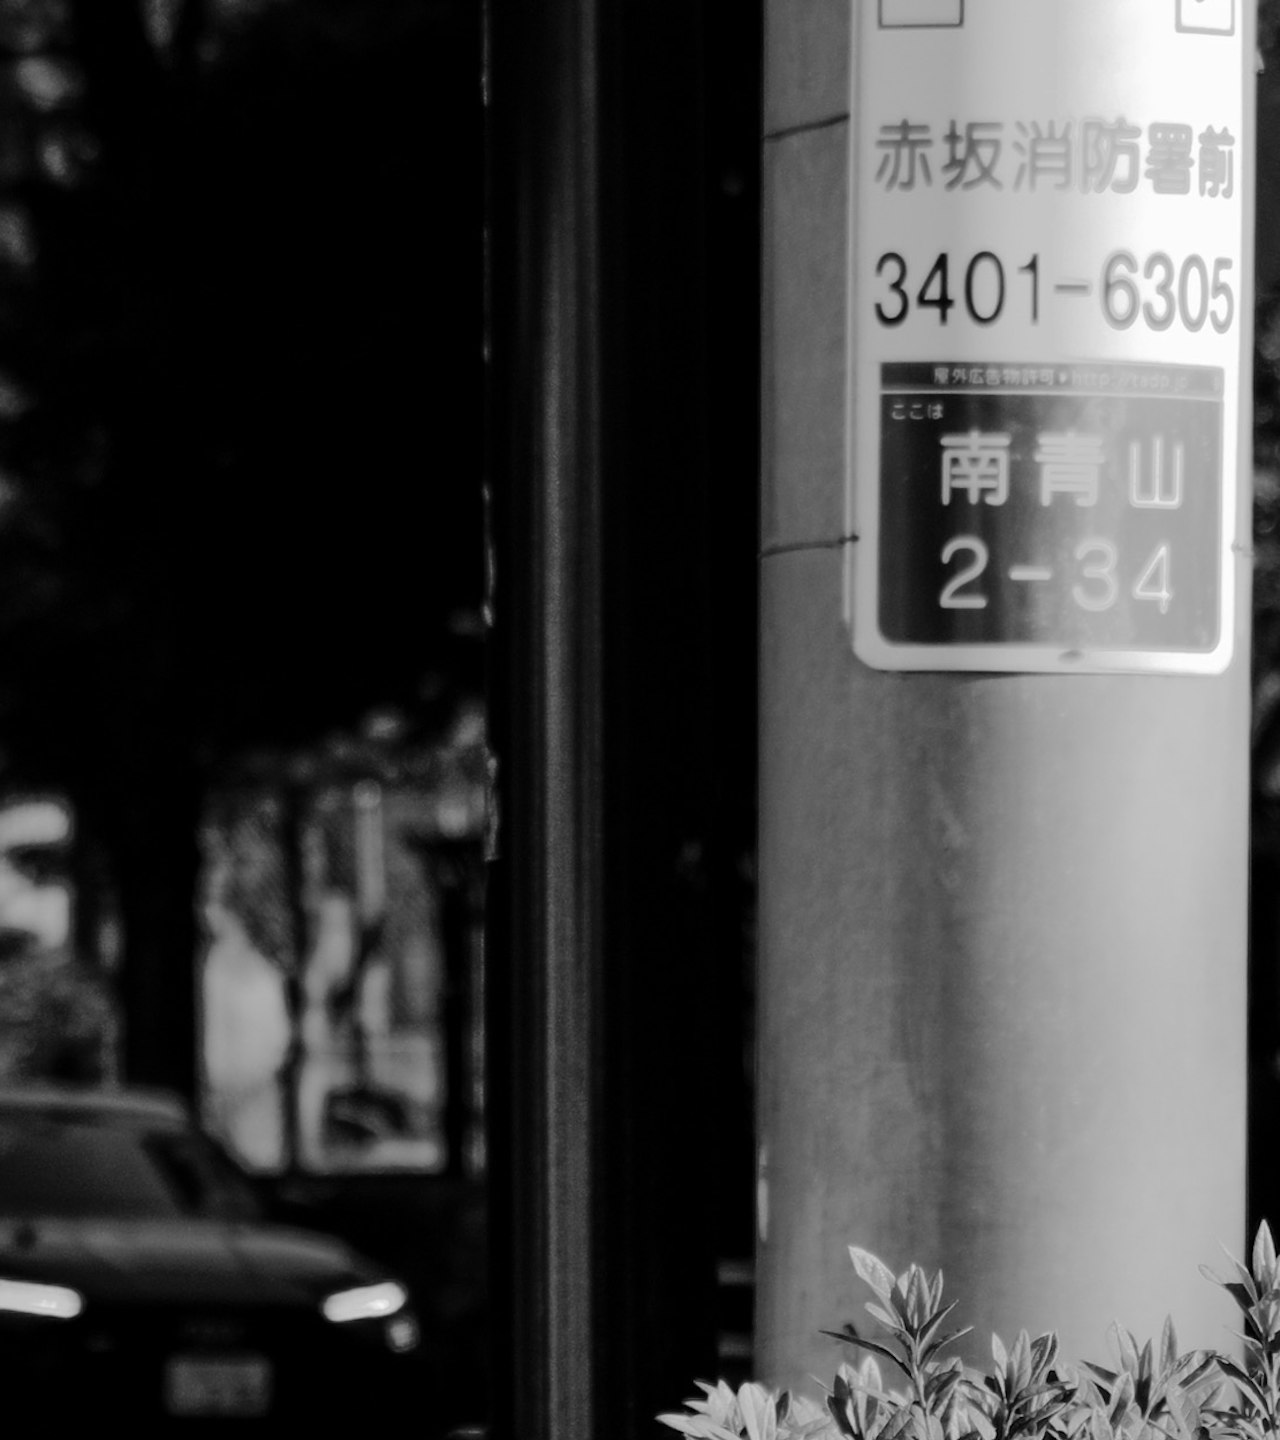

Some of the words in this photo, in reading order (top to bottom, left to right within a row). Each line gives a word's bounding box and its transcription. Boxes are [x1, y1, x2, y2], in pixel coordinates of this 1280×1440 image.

[874, 117, 1235, 199] 赤坂消防署前
[874, 249, 1234, 334] 3401-6305
[891, 403, 943, 420] ここは
[940, 430, 1183, 509] 南青山
[939, 535, 1171, 614] 2-34
